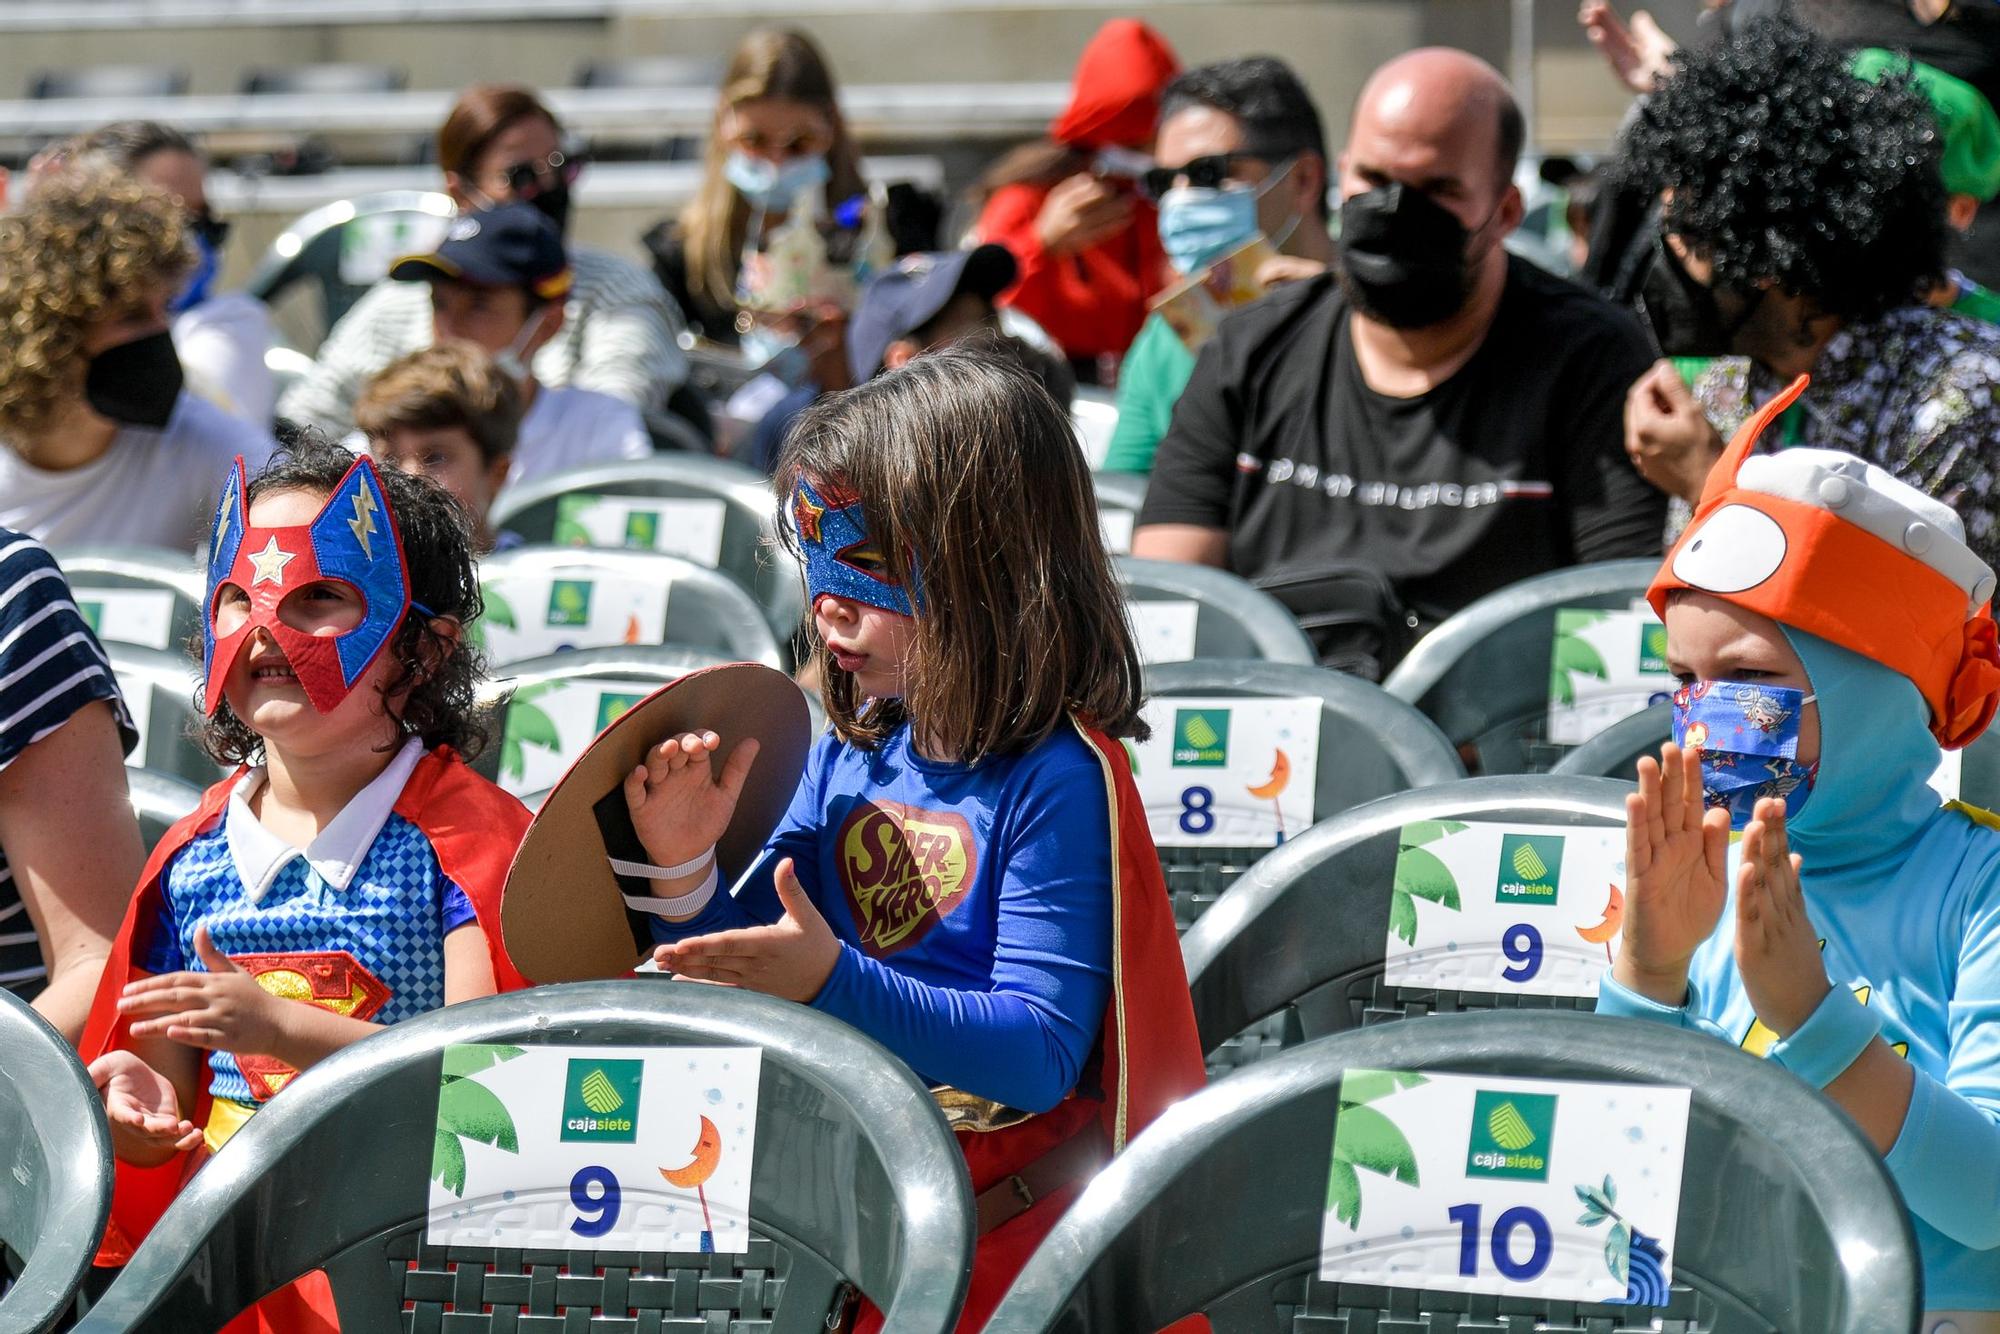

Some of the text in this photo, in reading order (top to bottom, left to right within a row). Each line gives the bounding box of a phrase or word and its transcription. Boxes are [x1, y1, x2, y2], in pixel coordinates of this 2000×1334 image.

[1179, 786, 1214, 834] 8
[849, 810, 952, 889] SUPER
[861, 875, 942, 943] HERO
[1501, 882, 1554, 896] cajasiete
[1502, 923, 1544, 983] 9
[567, 1117, 631, 1133] cajasiete
[1473, 1153, 1544, 1171] cajasiete
[570, 1165, 621, 1238] 9
[1448, 1203, 1554, 1283] 10
